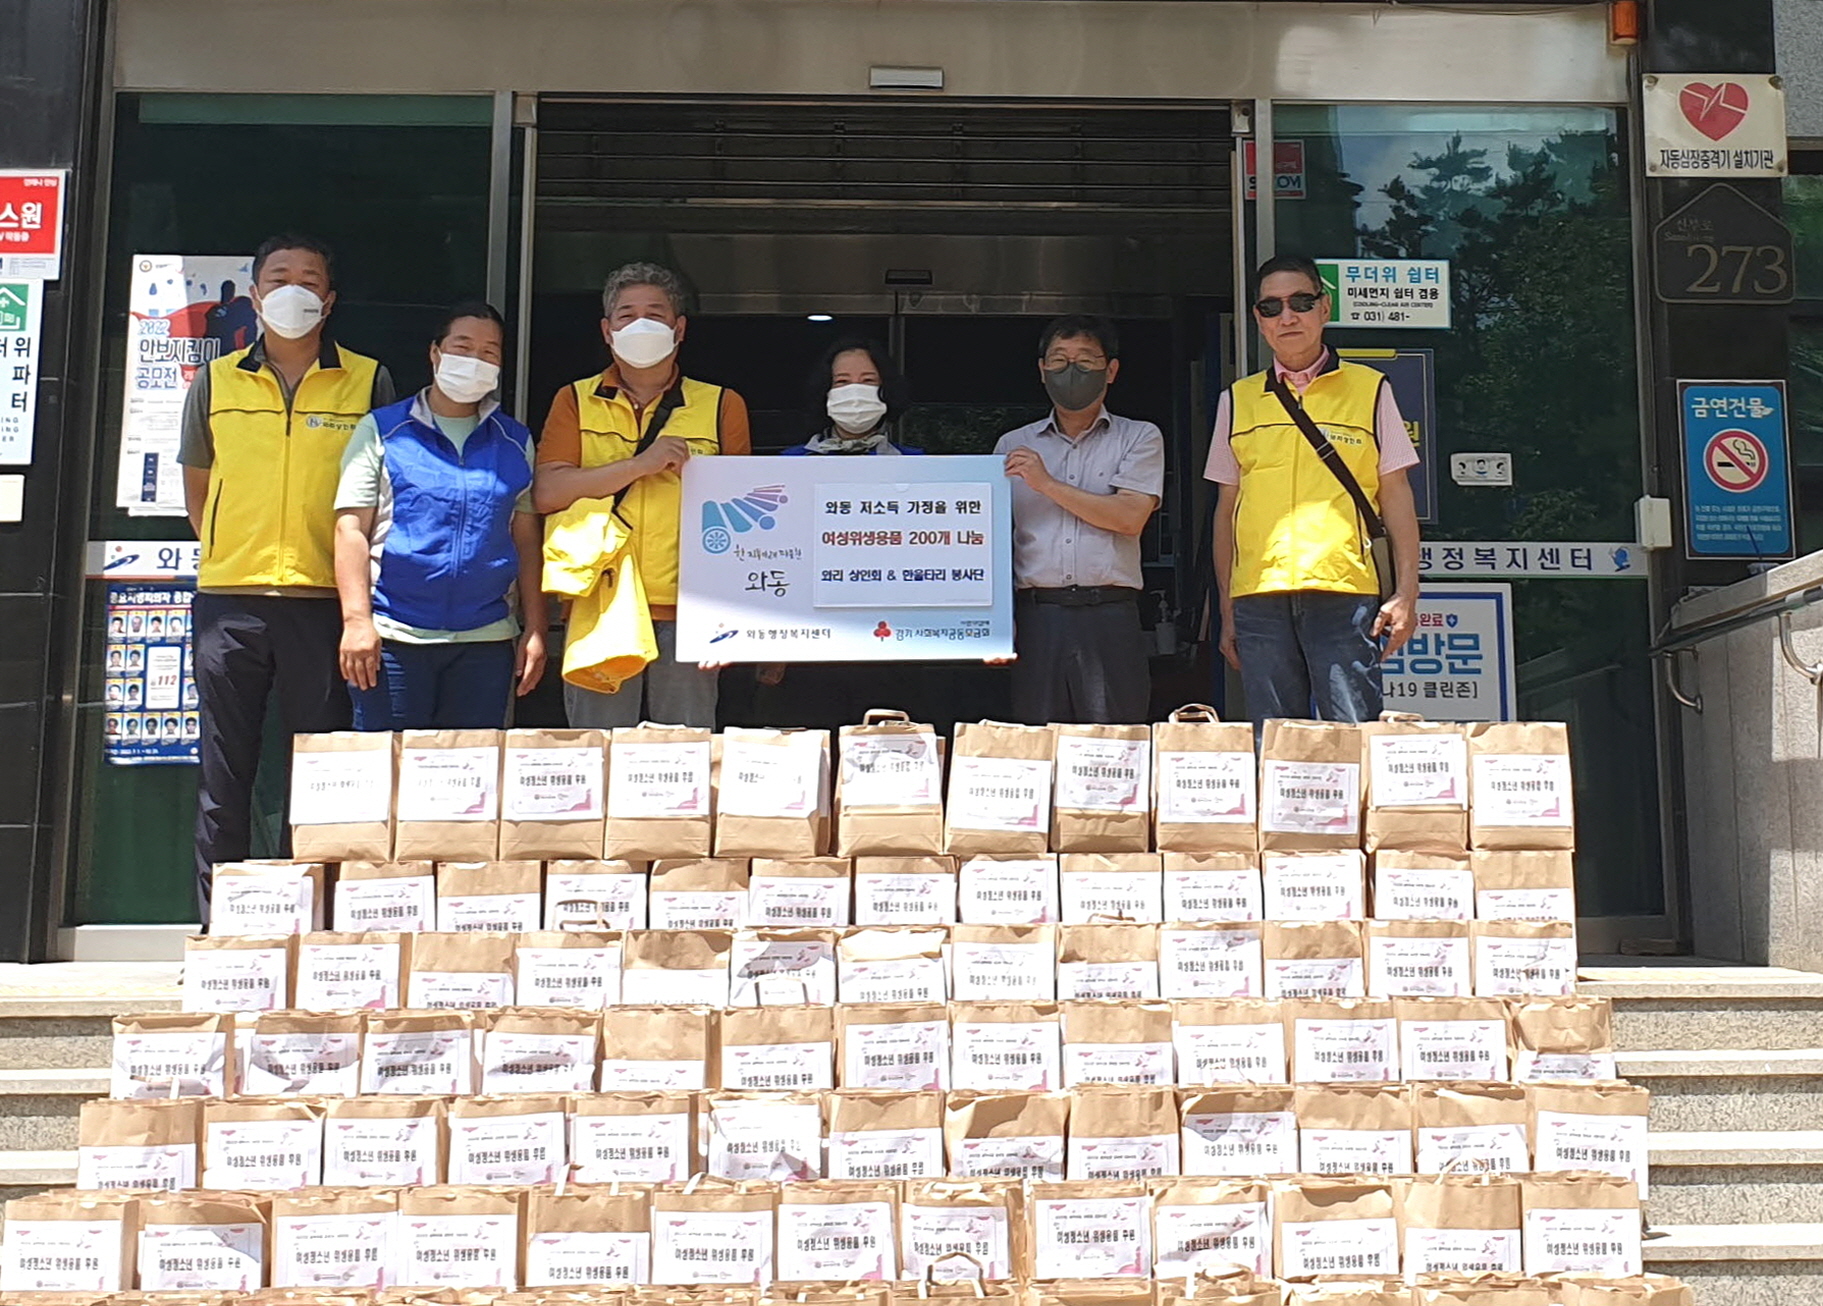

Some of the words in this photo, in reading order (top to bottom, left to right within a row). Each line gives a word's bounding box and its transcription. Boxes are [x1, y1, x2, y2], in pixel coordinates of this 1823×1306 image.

[1660, 150, 1730, 170] 자동심장충격기
[1733, 149, 1774, 169] 설치기관
[1345, 266, 1397, 283] 무더위
[1407, 266, 1440, 284] 쉼터
[1686, 244, 1788, 294] 273
[1347, 288, 1389, 299] 미세먼지
[1393, 288, 1414, 299] 쉼터
[1418, 288, 1439, 300] 겸용
[140, 338, 220, 363] 안보지킴이
[136, 367, 177, 390] 공모전
[1691, 397, 1765, 419] 금연건물
[825, 501, 851, 515] 와동
[860, 500, 899, 515] 저소득
[907, 501, 946, 515] 가정을
[955, 500, 981, 515] 위한
[822, 531, 902, 545] 여성위생용품
[909, 531, 950, 545] 200개
[957, 530, 983, 545] 나눔
[745, 570, 790, 597] 와동
[821, 569, 843, 582] 와리
[849, 569, 882, 581] 상인회
[887, 571, 897, 581] &
[903, 568, 946, 581] 한울타리
[952, 568, 984, 581] 봉사단
[1416, 613, 1443, 627] 완료
[746, 628, 831, 639] 와동행정복지센터
[895, 628, 913, 641] 경기
[1423, 682, 1477, 699] 클린존]
